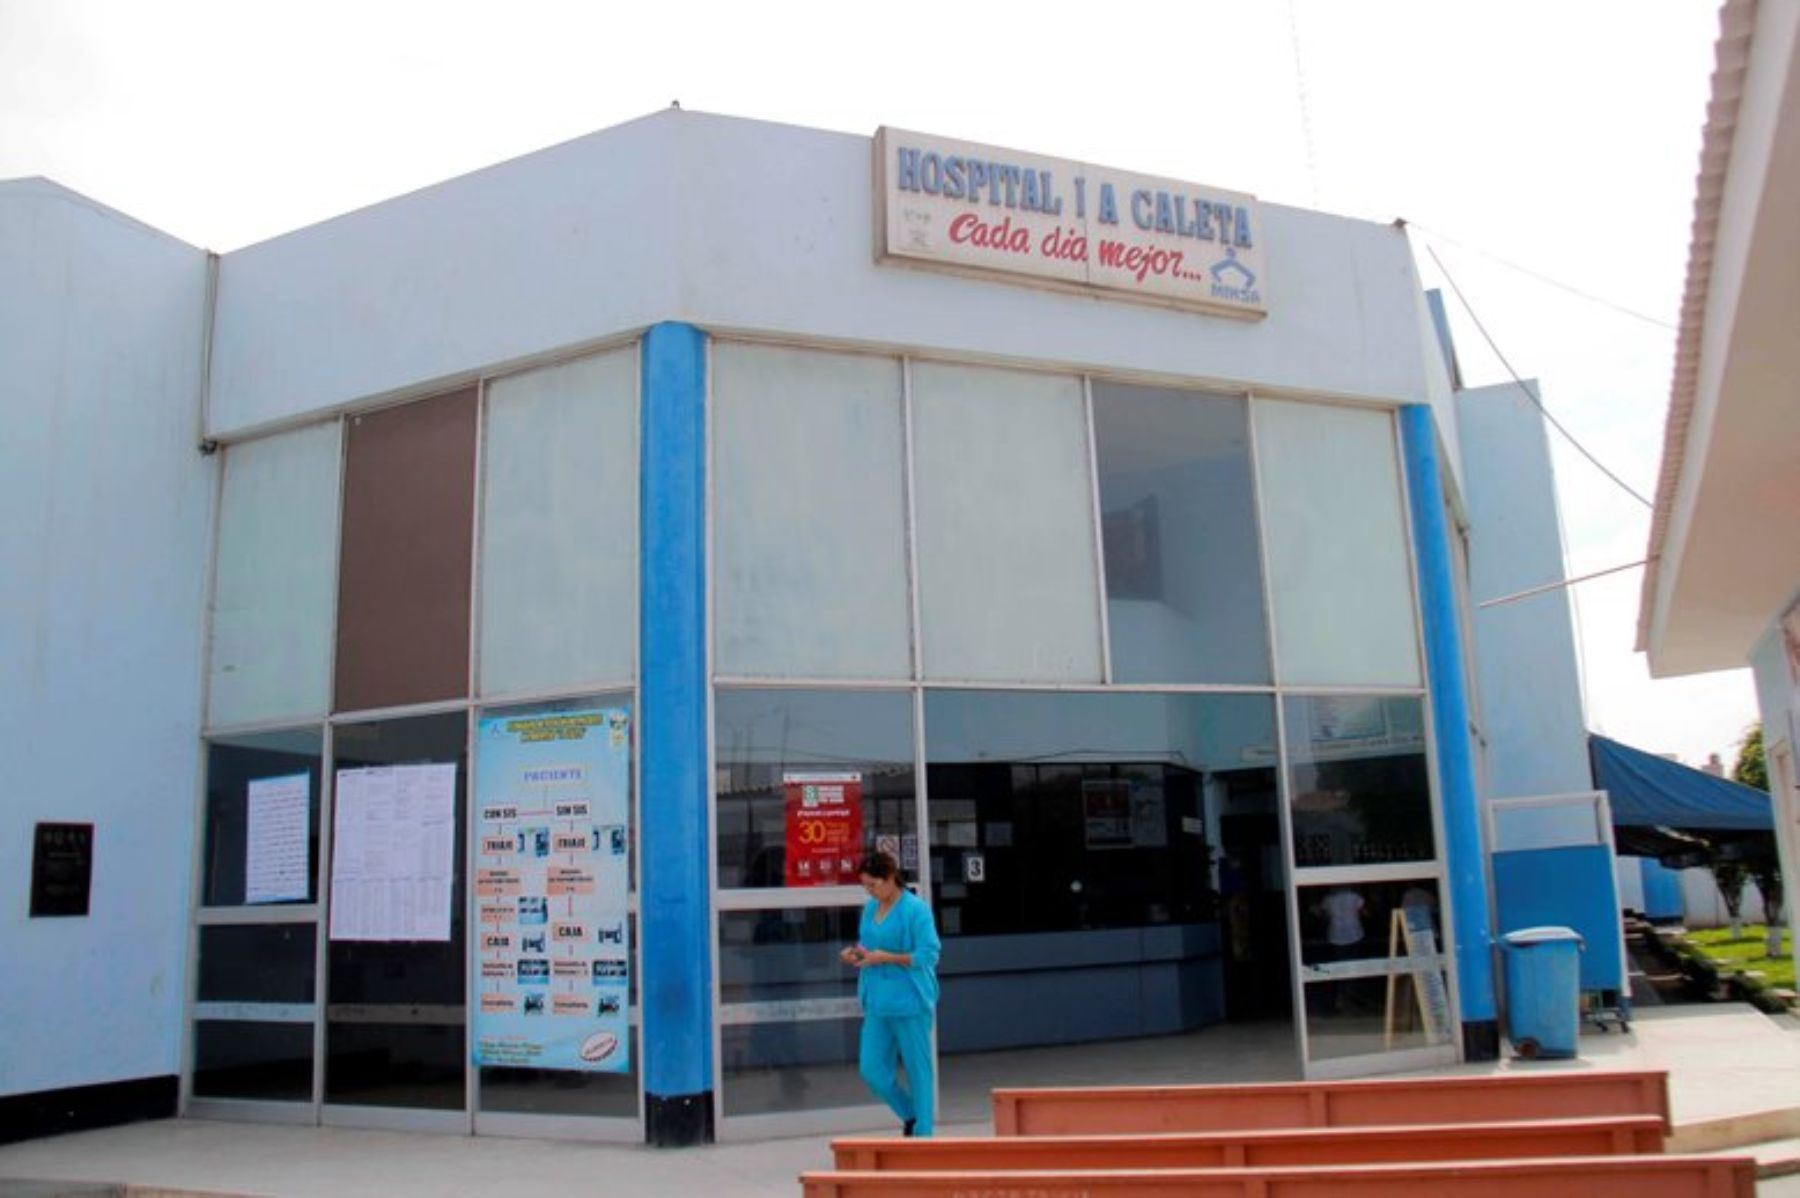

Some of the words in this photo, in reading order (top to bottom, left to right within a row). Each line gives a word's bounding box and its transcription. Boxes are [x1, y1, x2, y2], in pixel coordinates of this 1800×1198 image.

[897, 146, 1063, 216] HOSPITAL
[1130, 188, 1253, 249] CALETA
[948, 212, 1031, 257] Cada
[484, 809, 501, 820] CON
[503, 808, 517, 818] SIS
[556, 805, 571, 816] SIN
[573, 804, 587, 816] SIS
[799, 820, 826, 844] 30
[970, 859, 981, 877] 3
[559, 926, 583, 937] CAJA
[487, 936, 509, 947] CAJA
